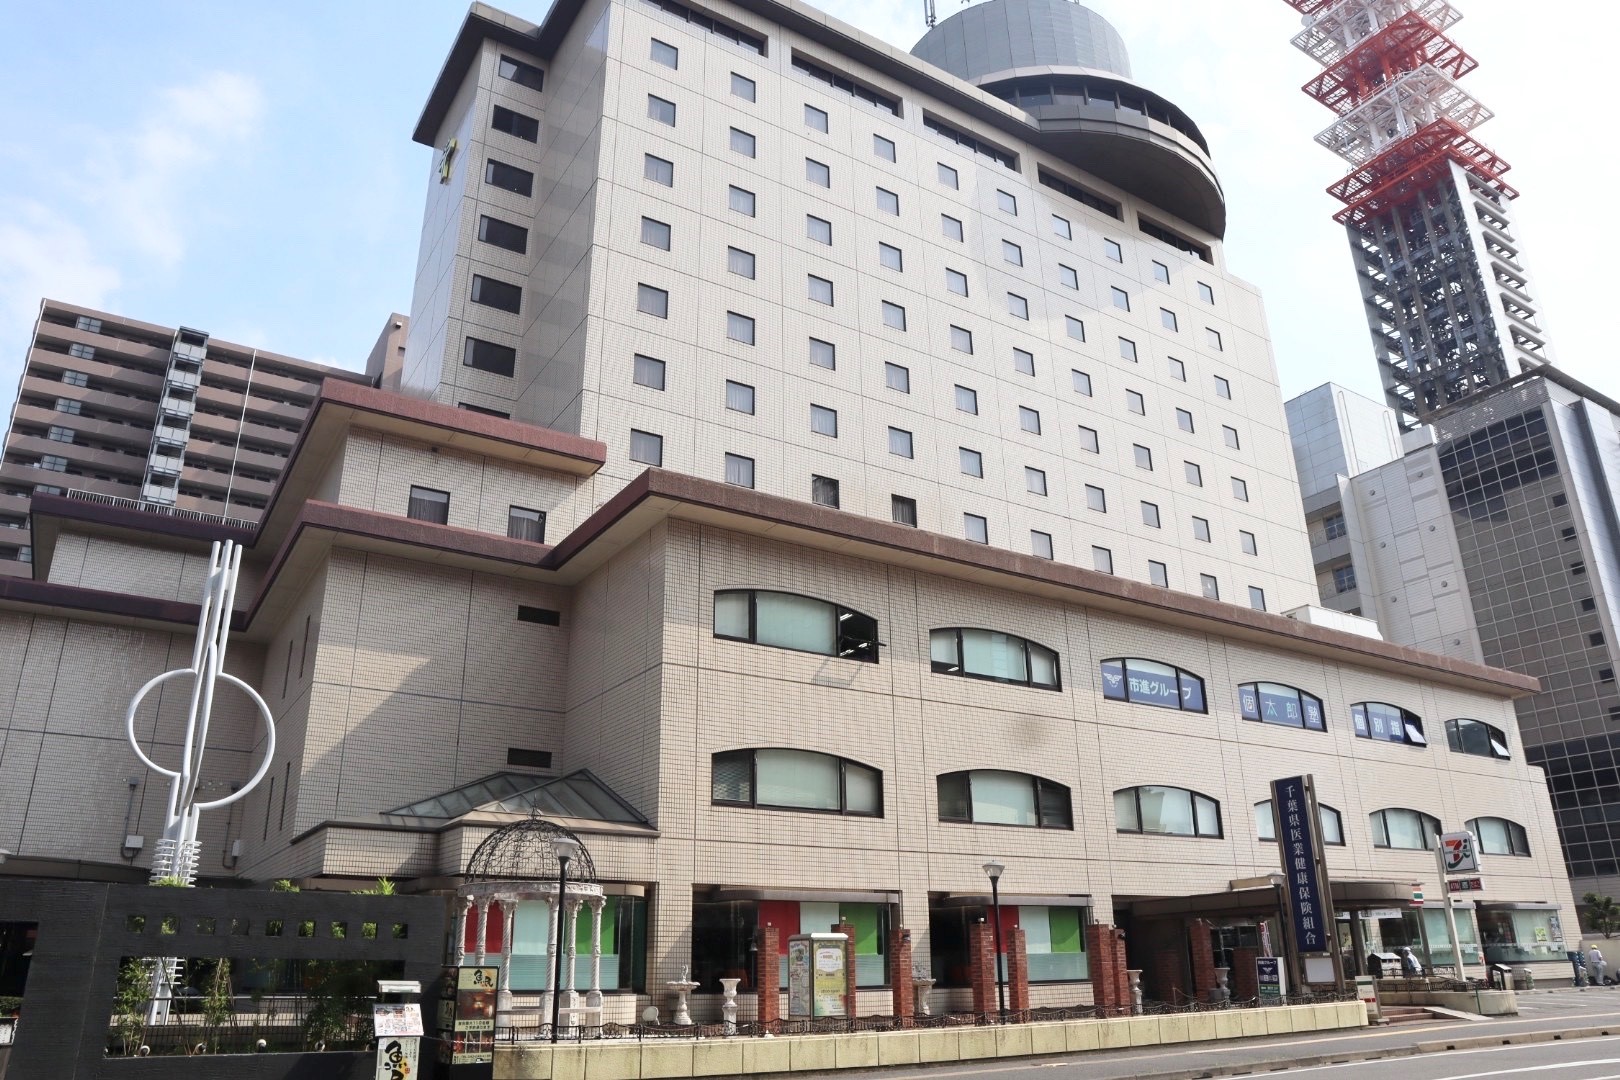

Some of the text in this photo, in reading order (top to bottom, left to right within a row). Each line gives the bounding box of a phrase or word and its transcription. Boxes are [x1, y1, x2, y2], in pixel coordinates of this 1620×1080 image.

[1128, 677, 1192, 699] 市進グループ
[1242, 694, 1320, 724] 個太郎塾
[1285, 785, 1317, 946] 千葉県医業健康保険組合
[473, 969, 494, 987] 魚民
